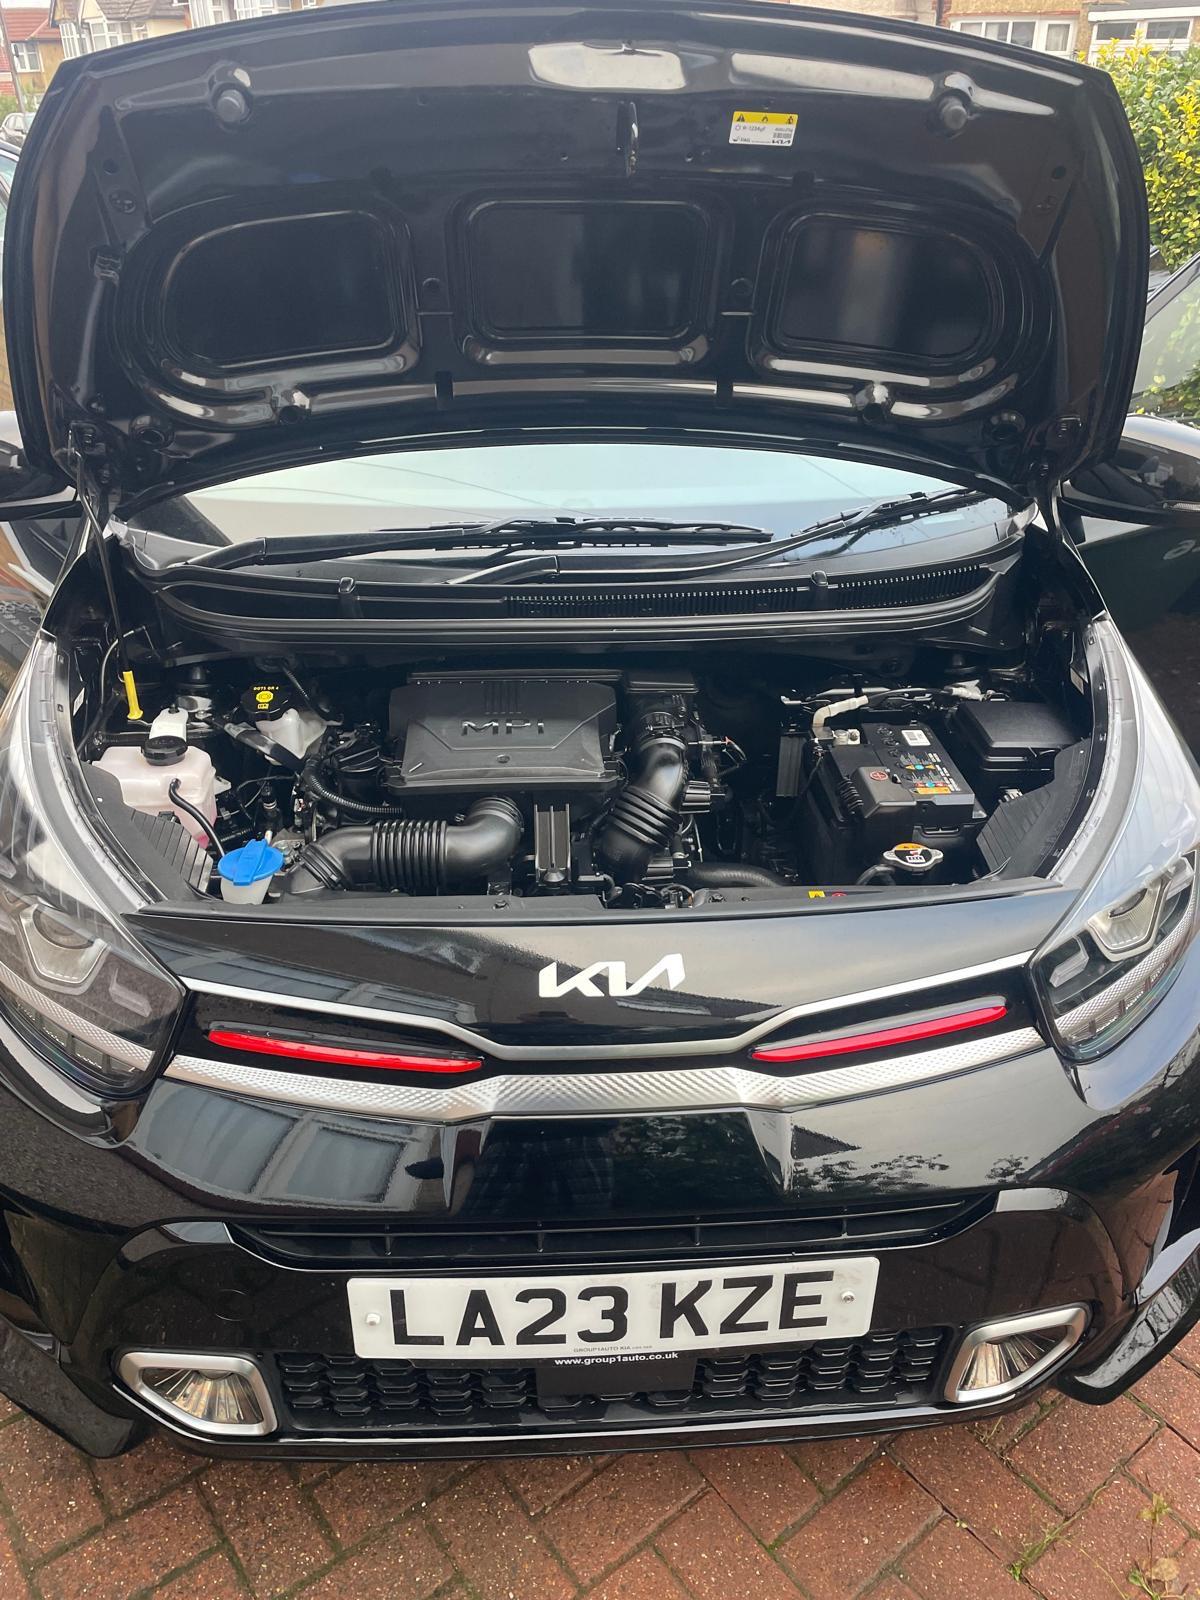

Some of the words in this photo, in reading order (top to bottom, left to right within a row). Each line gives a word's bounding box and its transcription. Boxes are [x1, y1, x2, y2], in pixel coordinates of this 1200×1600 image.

[461, 719, 545, 735] MPI
[538, 953, 686, 998] KIA
[390, 1286, 629, 1346] LA23
[659, 1271, 835, 1339] KZE
[554, 1352, 679, 1366] www.group1auto.co.uk
